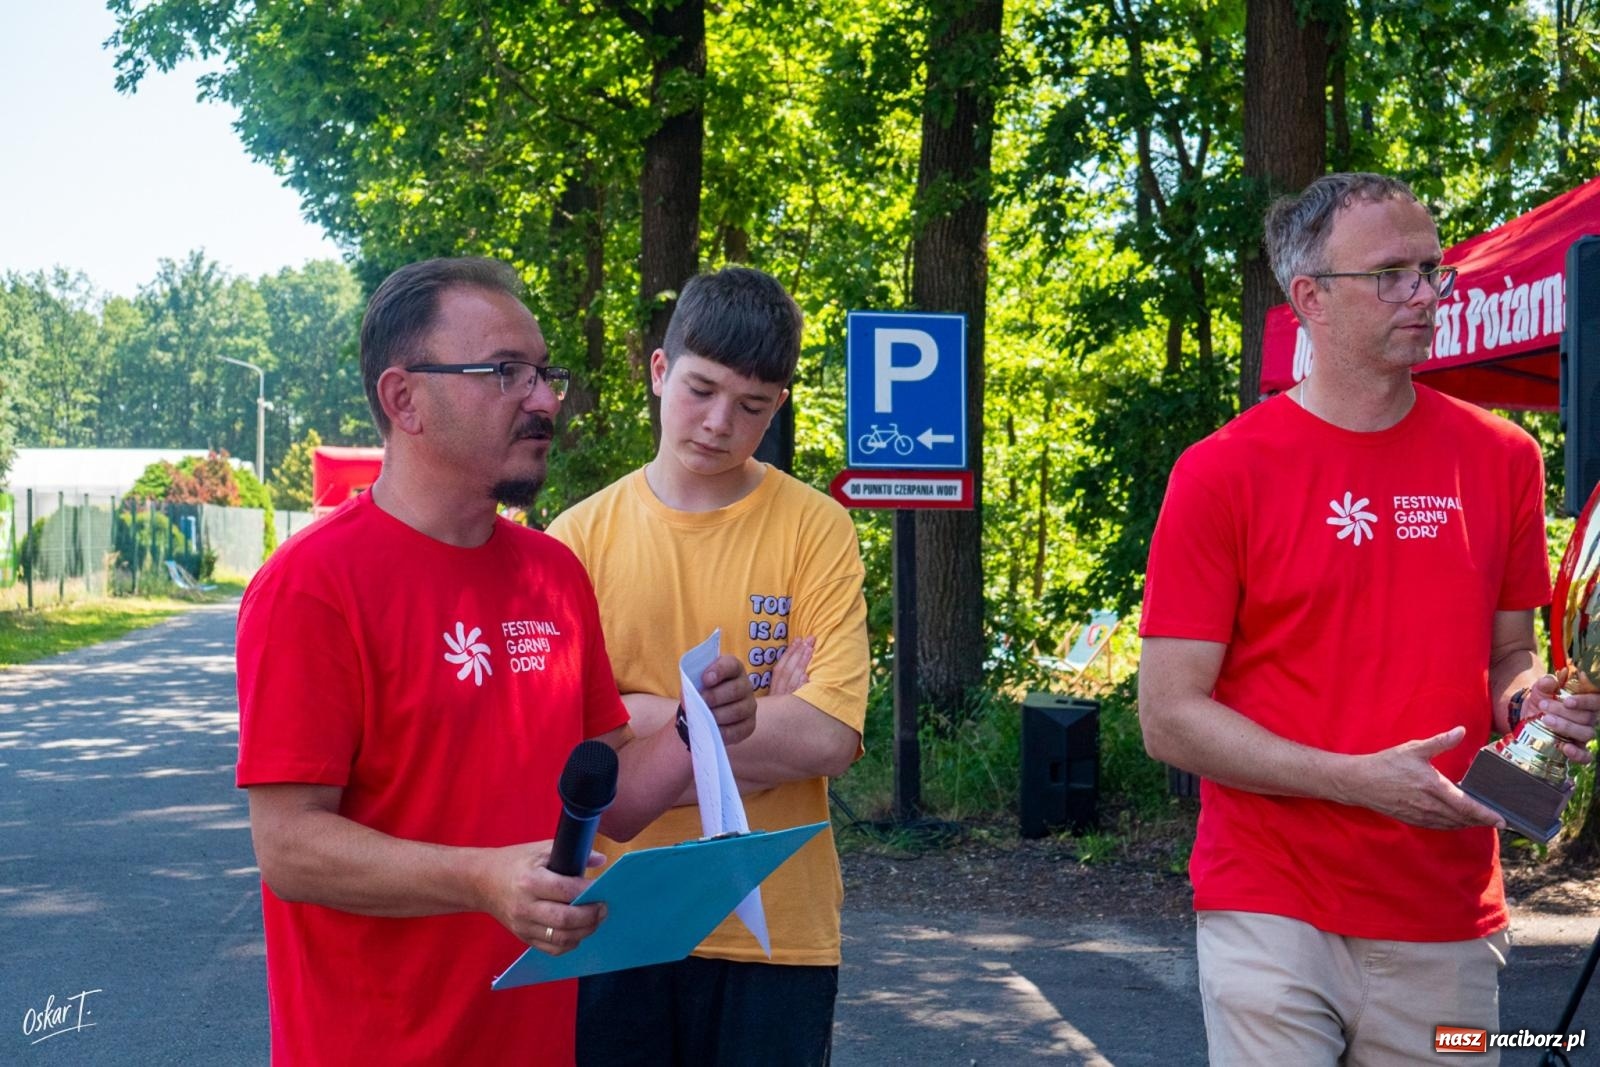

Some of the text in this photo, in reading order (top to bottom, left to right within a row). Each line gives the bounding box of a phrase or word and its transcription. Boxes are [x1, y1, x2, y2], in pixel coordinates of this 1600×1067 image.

[1428, 272, 1566, 360] aż Pożarn
[874, 327, 939, 414] P
[850, 483, 958, 497] DO PUNKTU CZERPANIA WODY
[1393, 496, 1463, 511] FESTIWAL
[1396, 525, 1439, 539] ODRY
[750, 594, 792, 616] TOD
[501, 620, 561, 638] FESTIWAL
[749, 620, 788, 640] IS A
[510, 655, 545, 673] ODRY
[748, 671, 772, 691] DA
